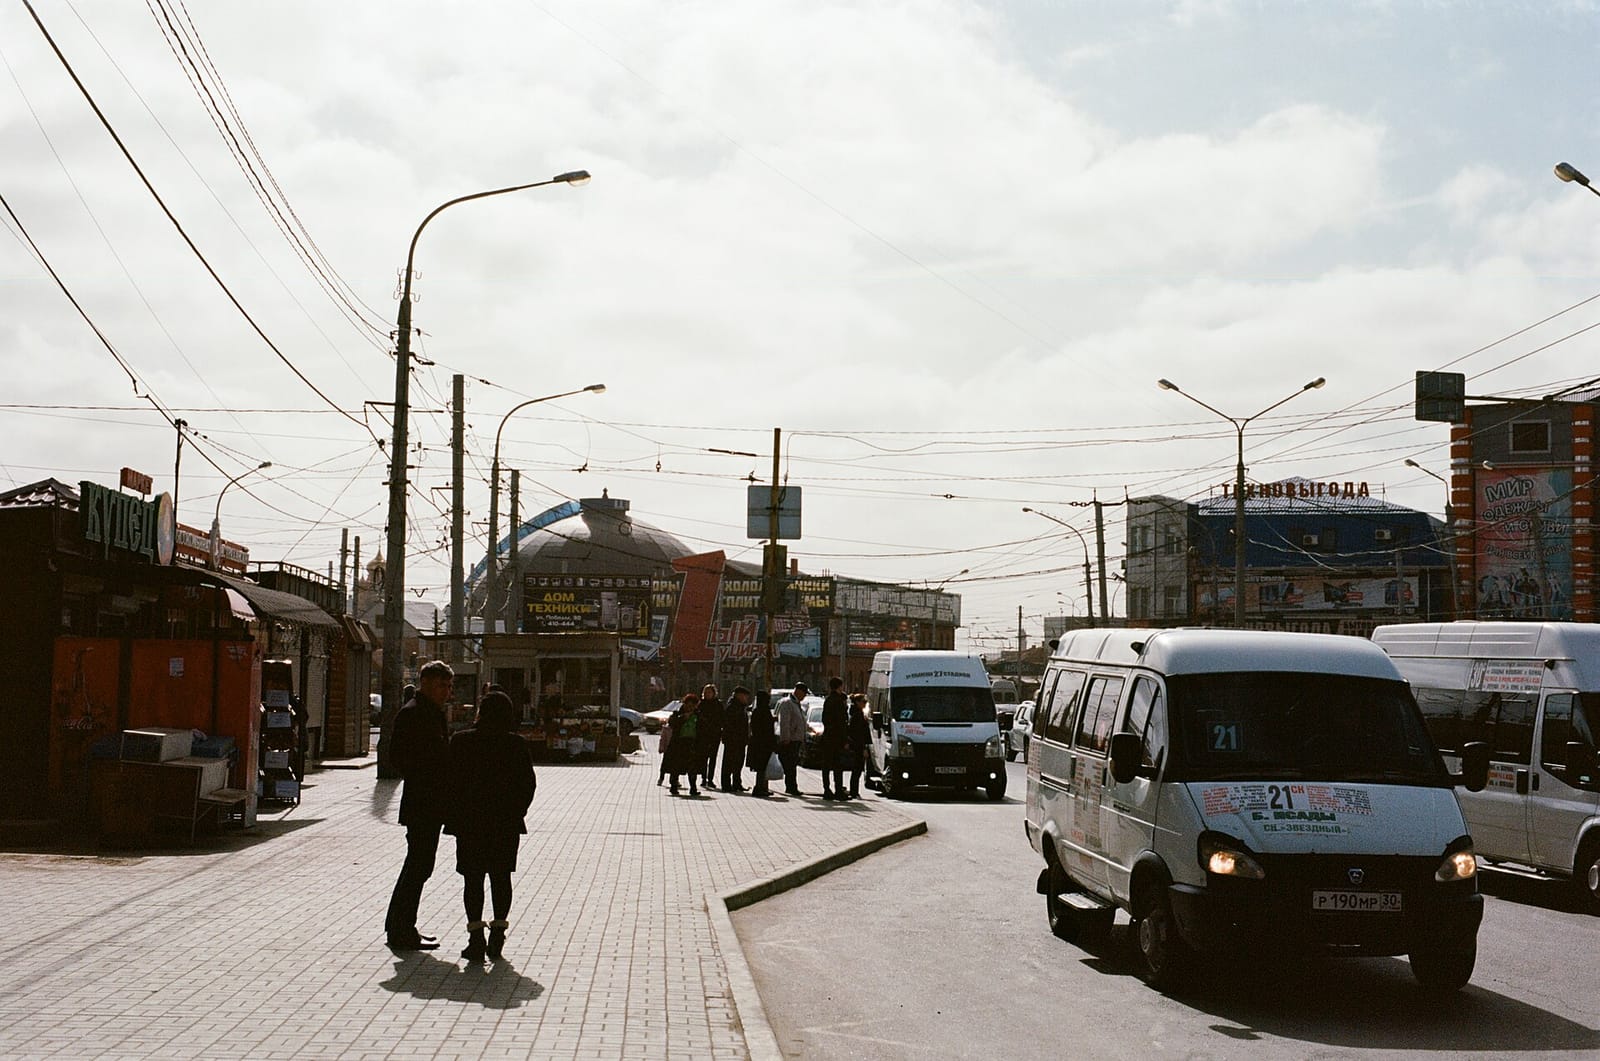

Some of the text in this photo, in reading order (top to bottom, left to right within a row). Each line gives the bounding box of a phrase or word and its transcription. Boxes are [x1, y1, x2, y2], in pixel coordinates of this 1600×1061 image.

[1485, 478, 1534, 502] МИР
[527, 603, 592, 613] ТЕХНИКИ
[543, 592, 575, 602] ДОМ
[1214, 725, 1237, 749] 21
[1268, 785, 1294, 810] 21
